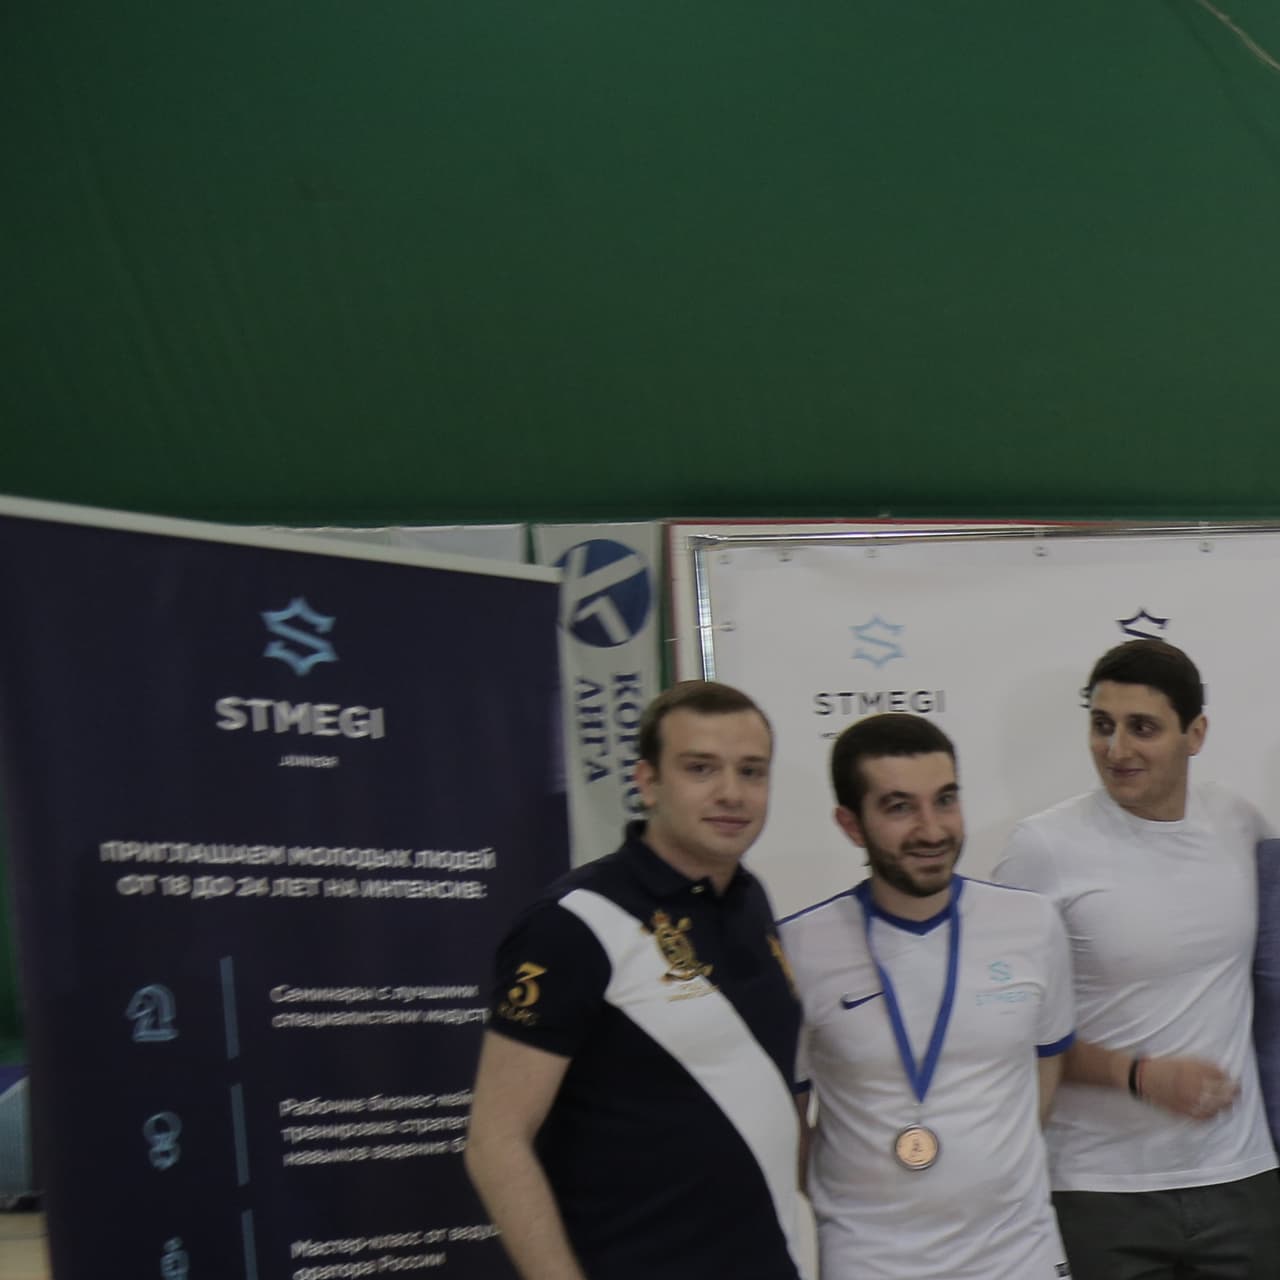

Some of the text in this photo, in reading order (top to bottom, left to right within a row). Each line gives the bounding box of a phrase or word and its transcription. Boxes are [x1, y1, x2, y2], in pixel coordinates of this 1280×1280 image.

[214, 696, 386, 739] STMEGI
[813, 690, 945, 715] STMEGI
[575, 677, 612, 785] ЛИГА
[117, 874, 159, 896] ОТ
[270, 877, 323, 898] ЛЕТ
